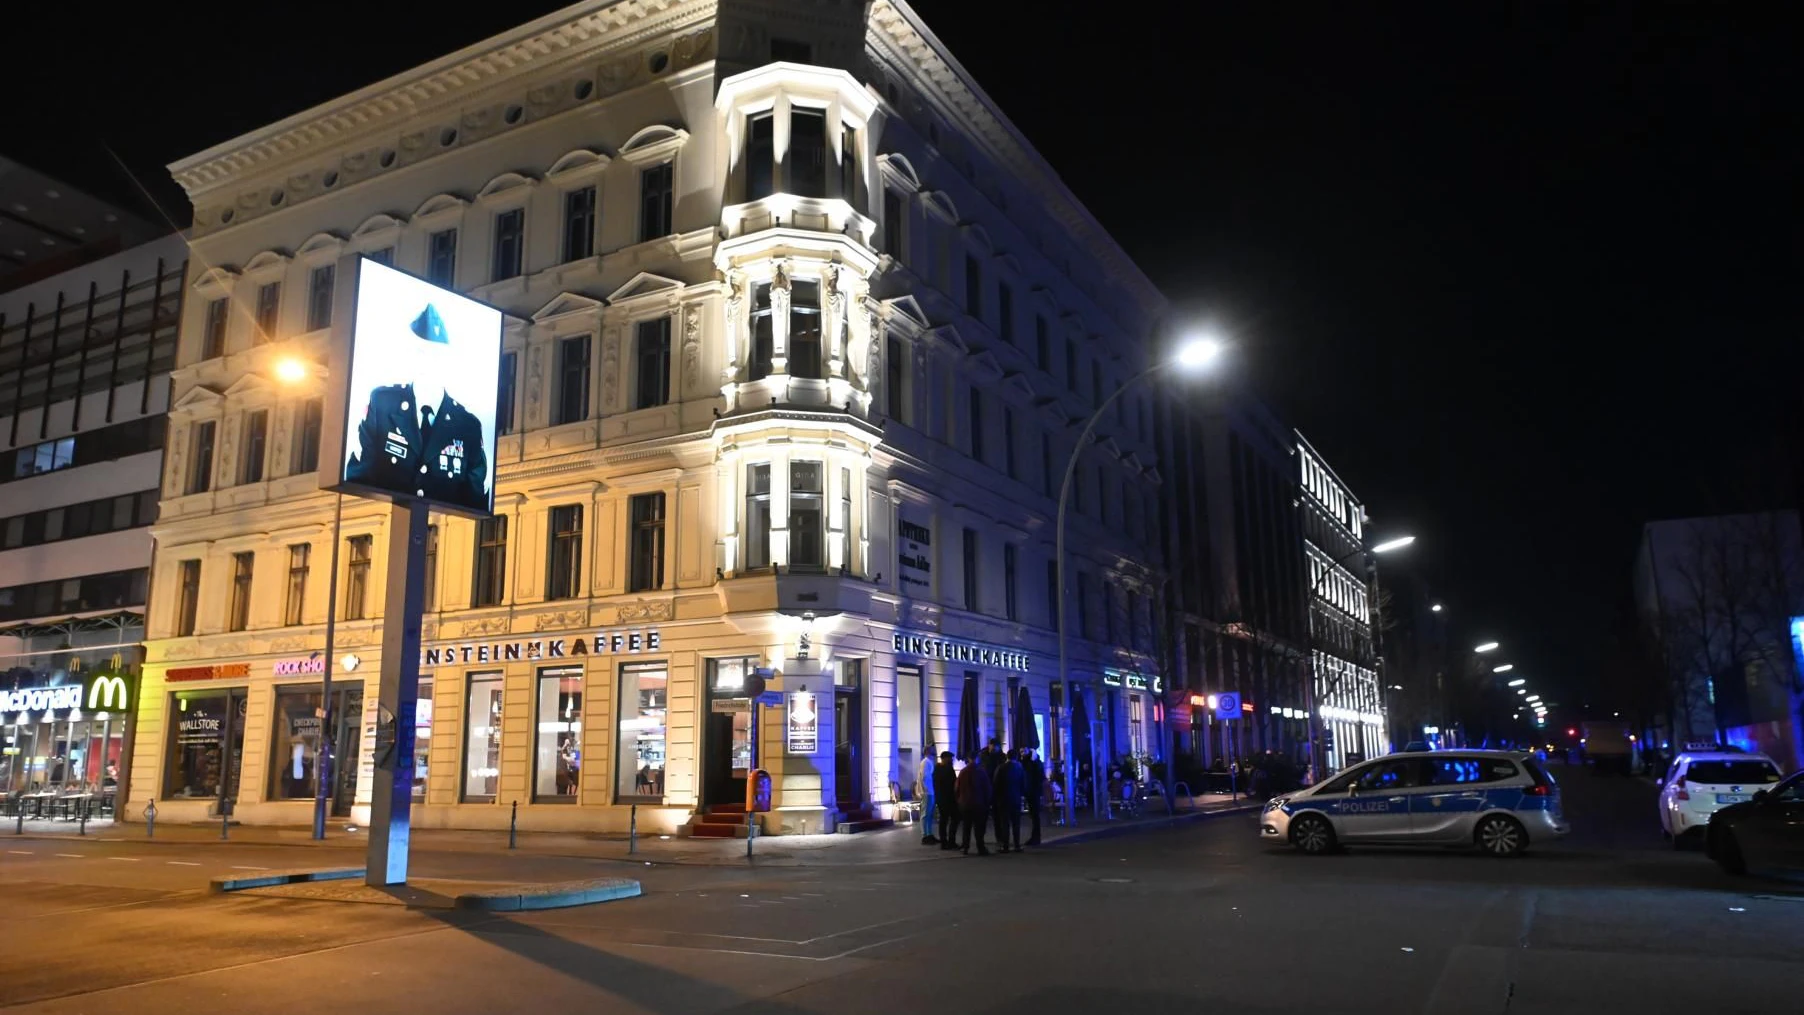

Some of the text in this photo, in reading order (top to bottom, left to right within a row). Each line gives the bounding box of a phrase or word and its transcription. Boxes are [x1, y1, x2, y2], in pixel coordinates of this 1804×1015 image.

[420, 632, 660, 665] NSTEIN KAFFEE
[892, 633, 1030, 672] EINSTEIN KAFFEE
[179, 719, 220, 731] WALLSTORE
[1342, 801, 1390, 812] POLIZEI
